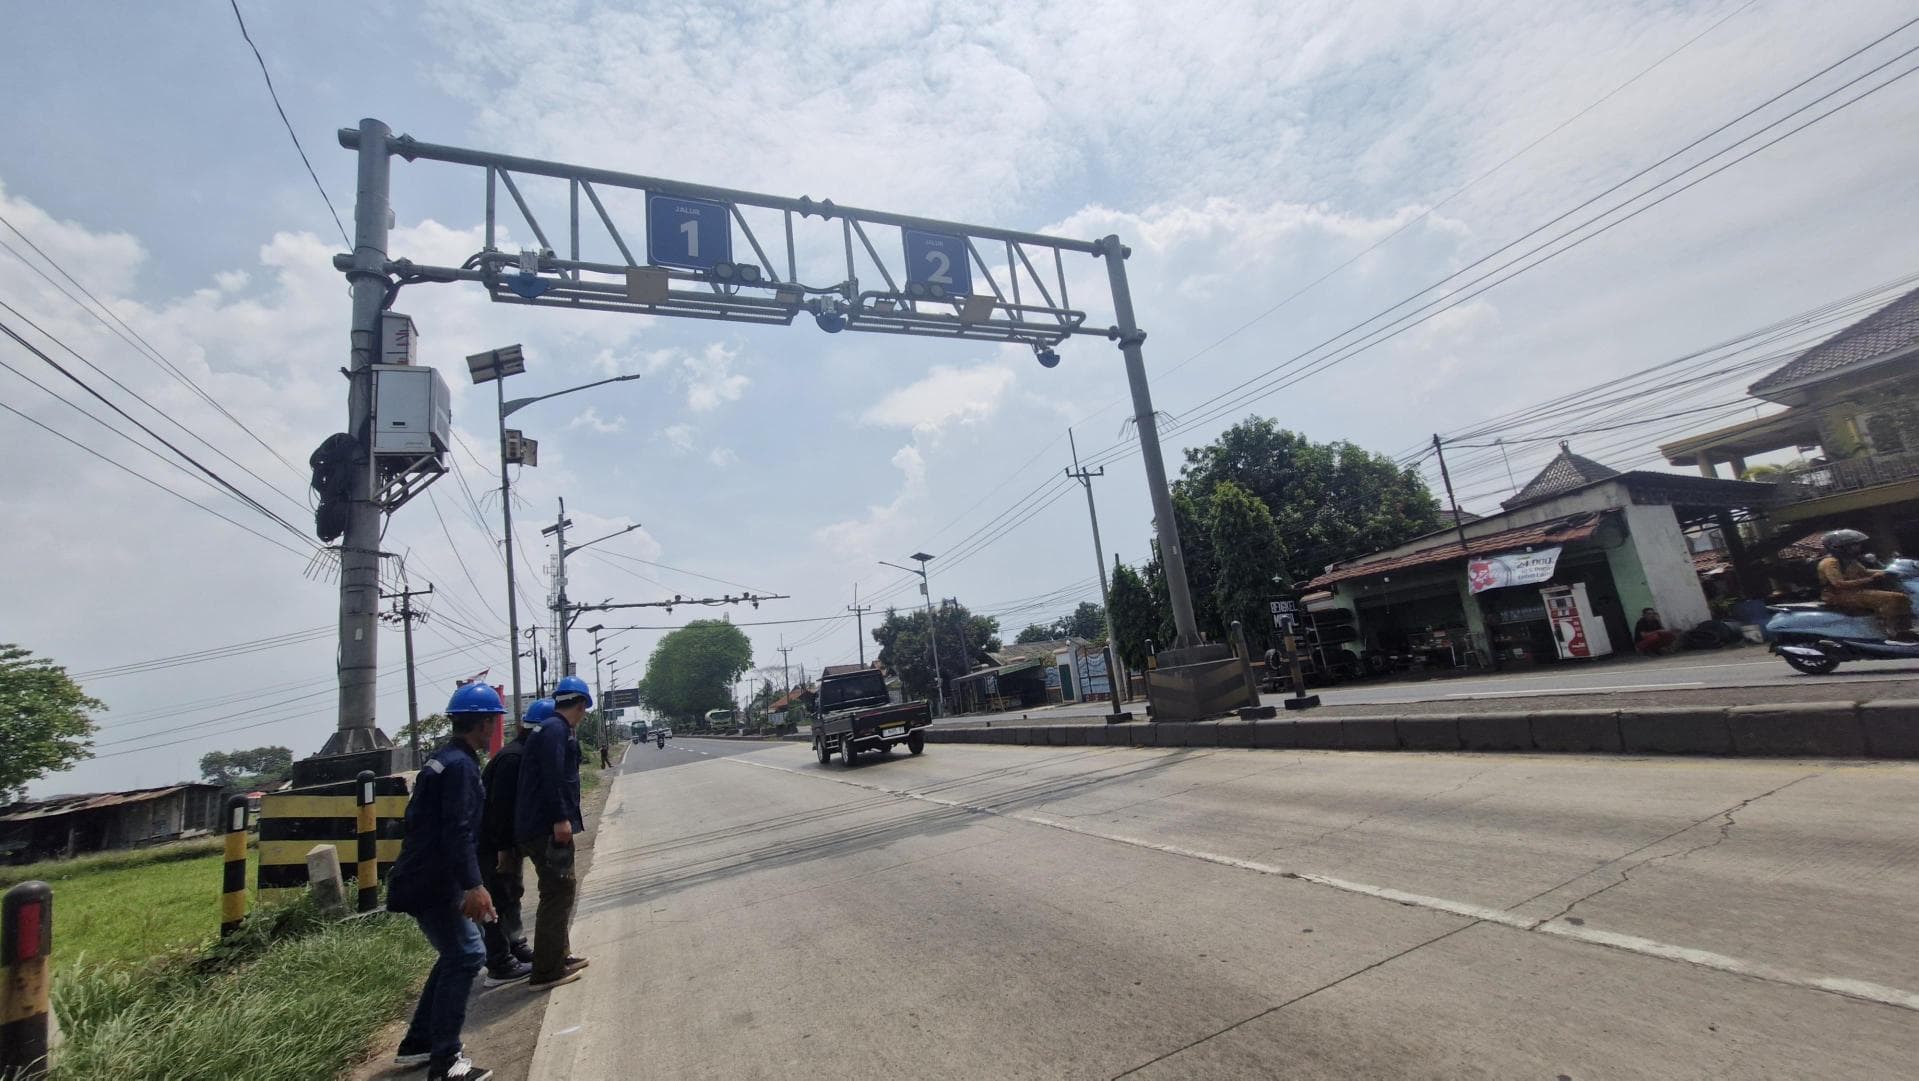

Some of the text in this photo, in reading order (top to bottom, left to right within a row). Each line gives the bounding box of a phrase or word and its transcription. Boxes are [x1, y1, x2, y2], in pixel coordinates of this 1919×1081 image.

[675, 206, 701, 215] JALUR
[680, 220, 699, 257] 1
[926, 250, 953, 284] 2
[1270, 600, 1298, 613] BENGKEL
